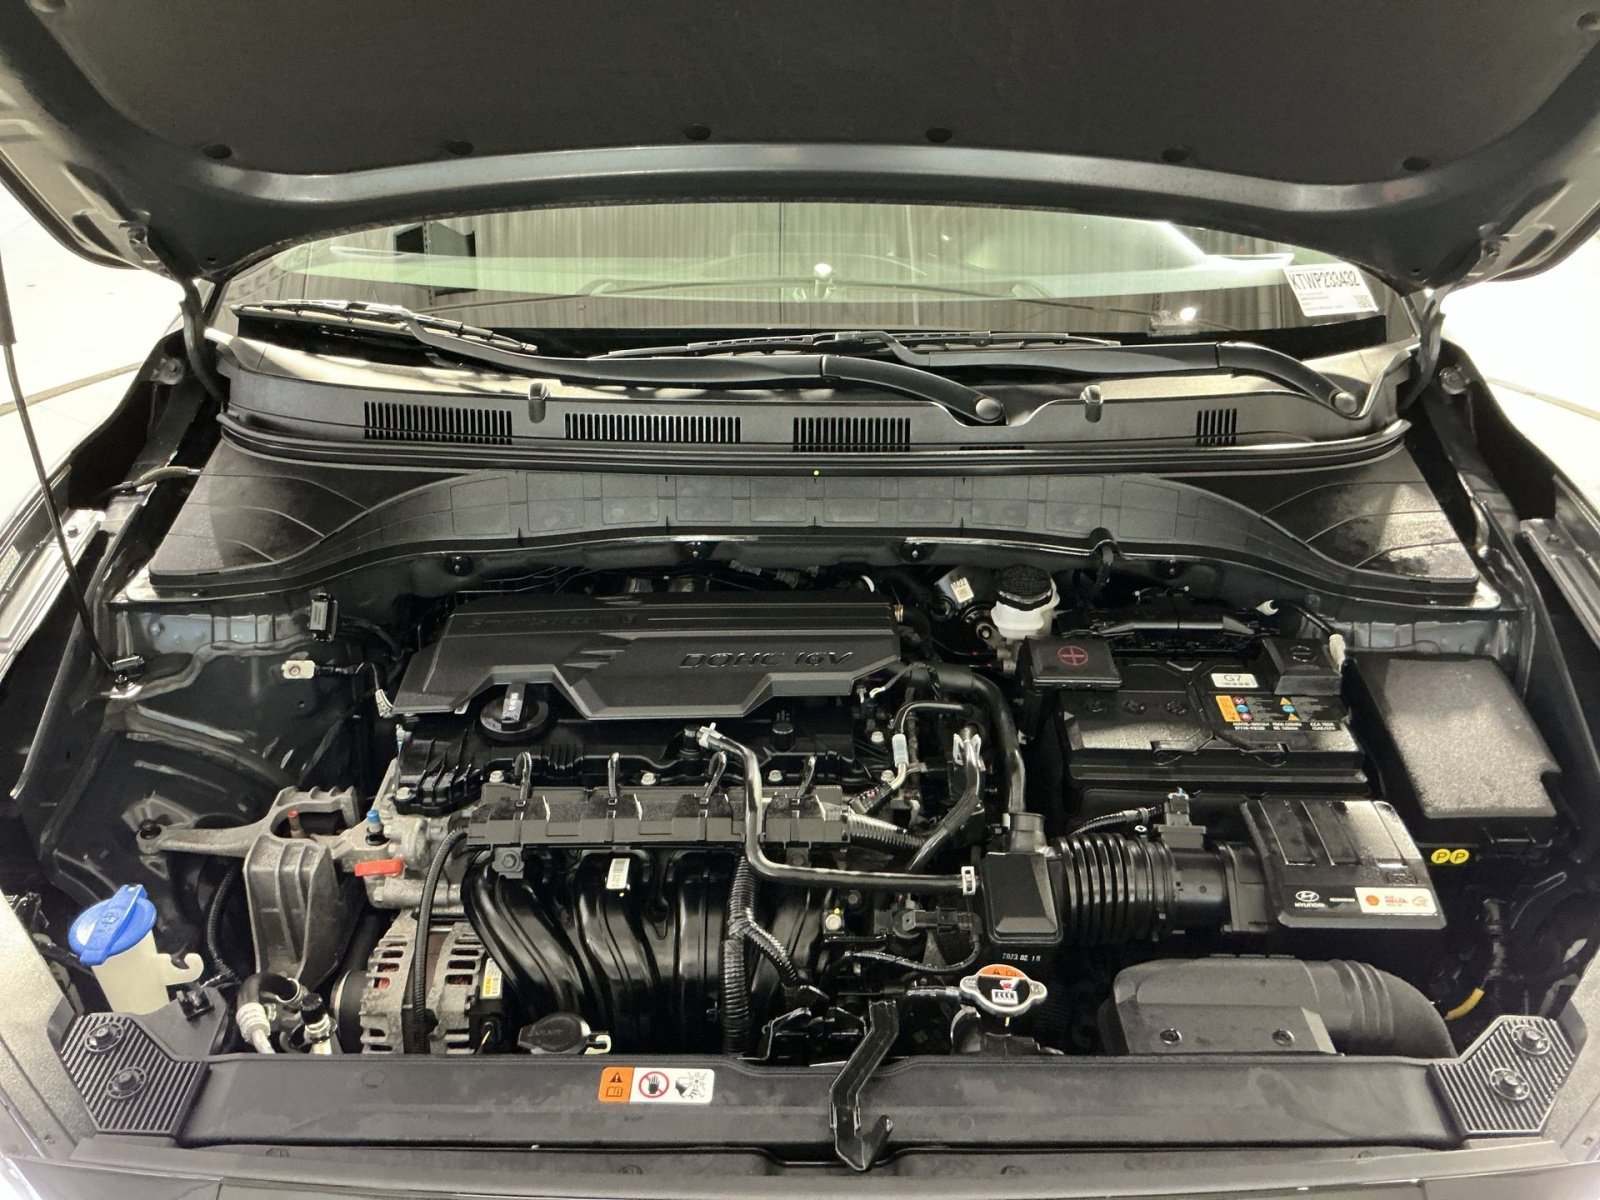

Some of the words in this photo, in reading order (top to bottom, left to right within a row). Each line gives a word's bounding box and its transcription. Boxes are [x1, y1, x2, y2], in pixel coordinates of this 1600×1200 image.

[679, 652, 785, 669] DOHC
[794, 651, 854, 667] 16V
[1223, 674, 1242, 682] G7
